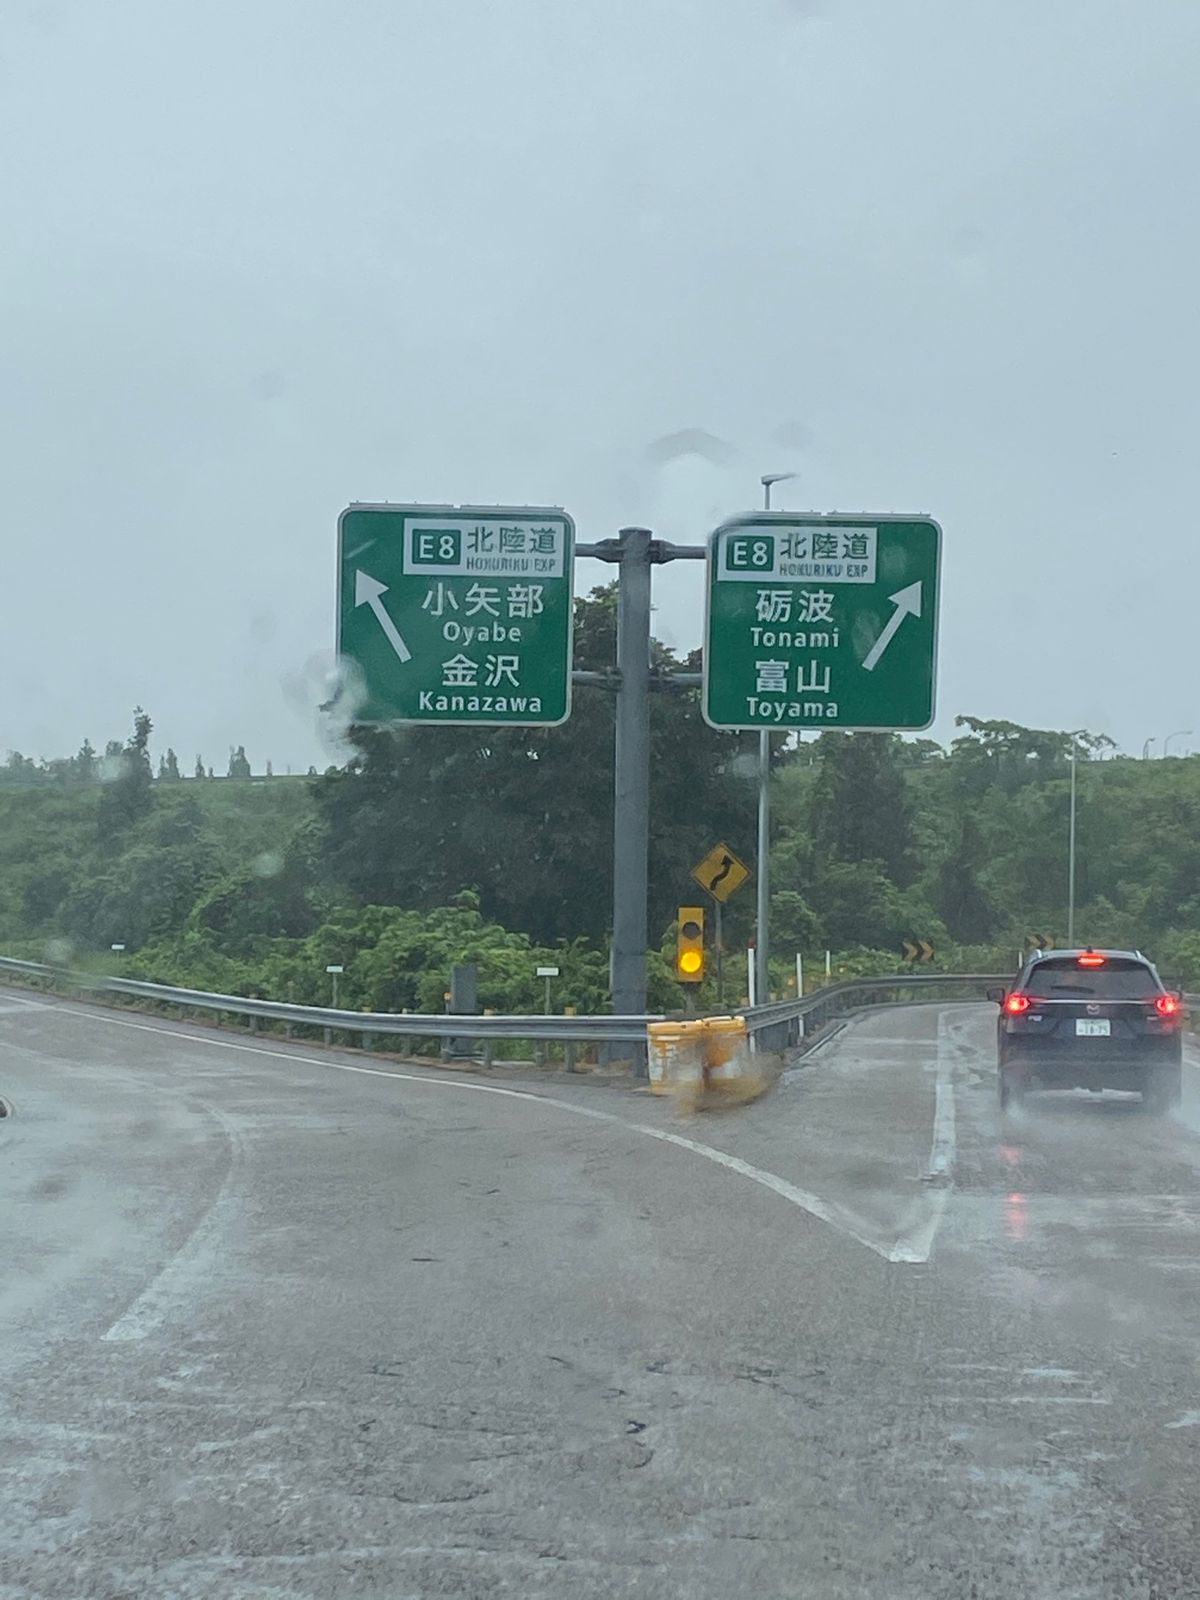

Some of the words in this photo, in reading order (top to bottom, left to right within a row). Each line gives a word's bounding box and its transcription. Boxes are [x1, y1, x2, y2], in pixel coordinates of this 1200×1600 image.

[419, 535, 455, 559] E8
[467, 526, 557, 554] 北陸道
[780, 533, 870, 560] 北陸道
[534, 558, 556, 570] EXP
[733, 541, 768, 566] E8
[779, 564, 842, 577] HOKURIKU
[847, 564, 868, 577] EXP
[421, 583, 544, 619] 小矢部
[755, 589, 835, 624] 砺波
[443, 621, 522, 646] Oyabe
[751, 627, 839, 648] Tonami
[442, 654, 520, 687] 金沢
[755, 659, 831, 694] 富山
[419, 691, 542, 713] Kanazawa
[747, 697, 838, 722] Toyama
